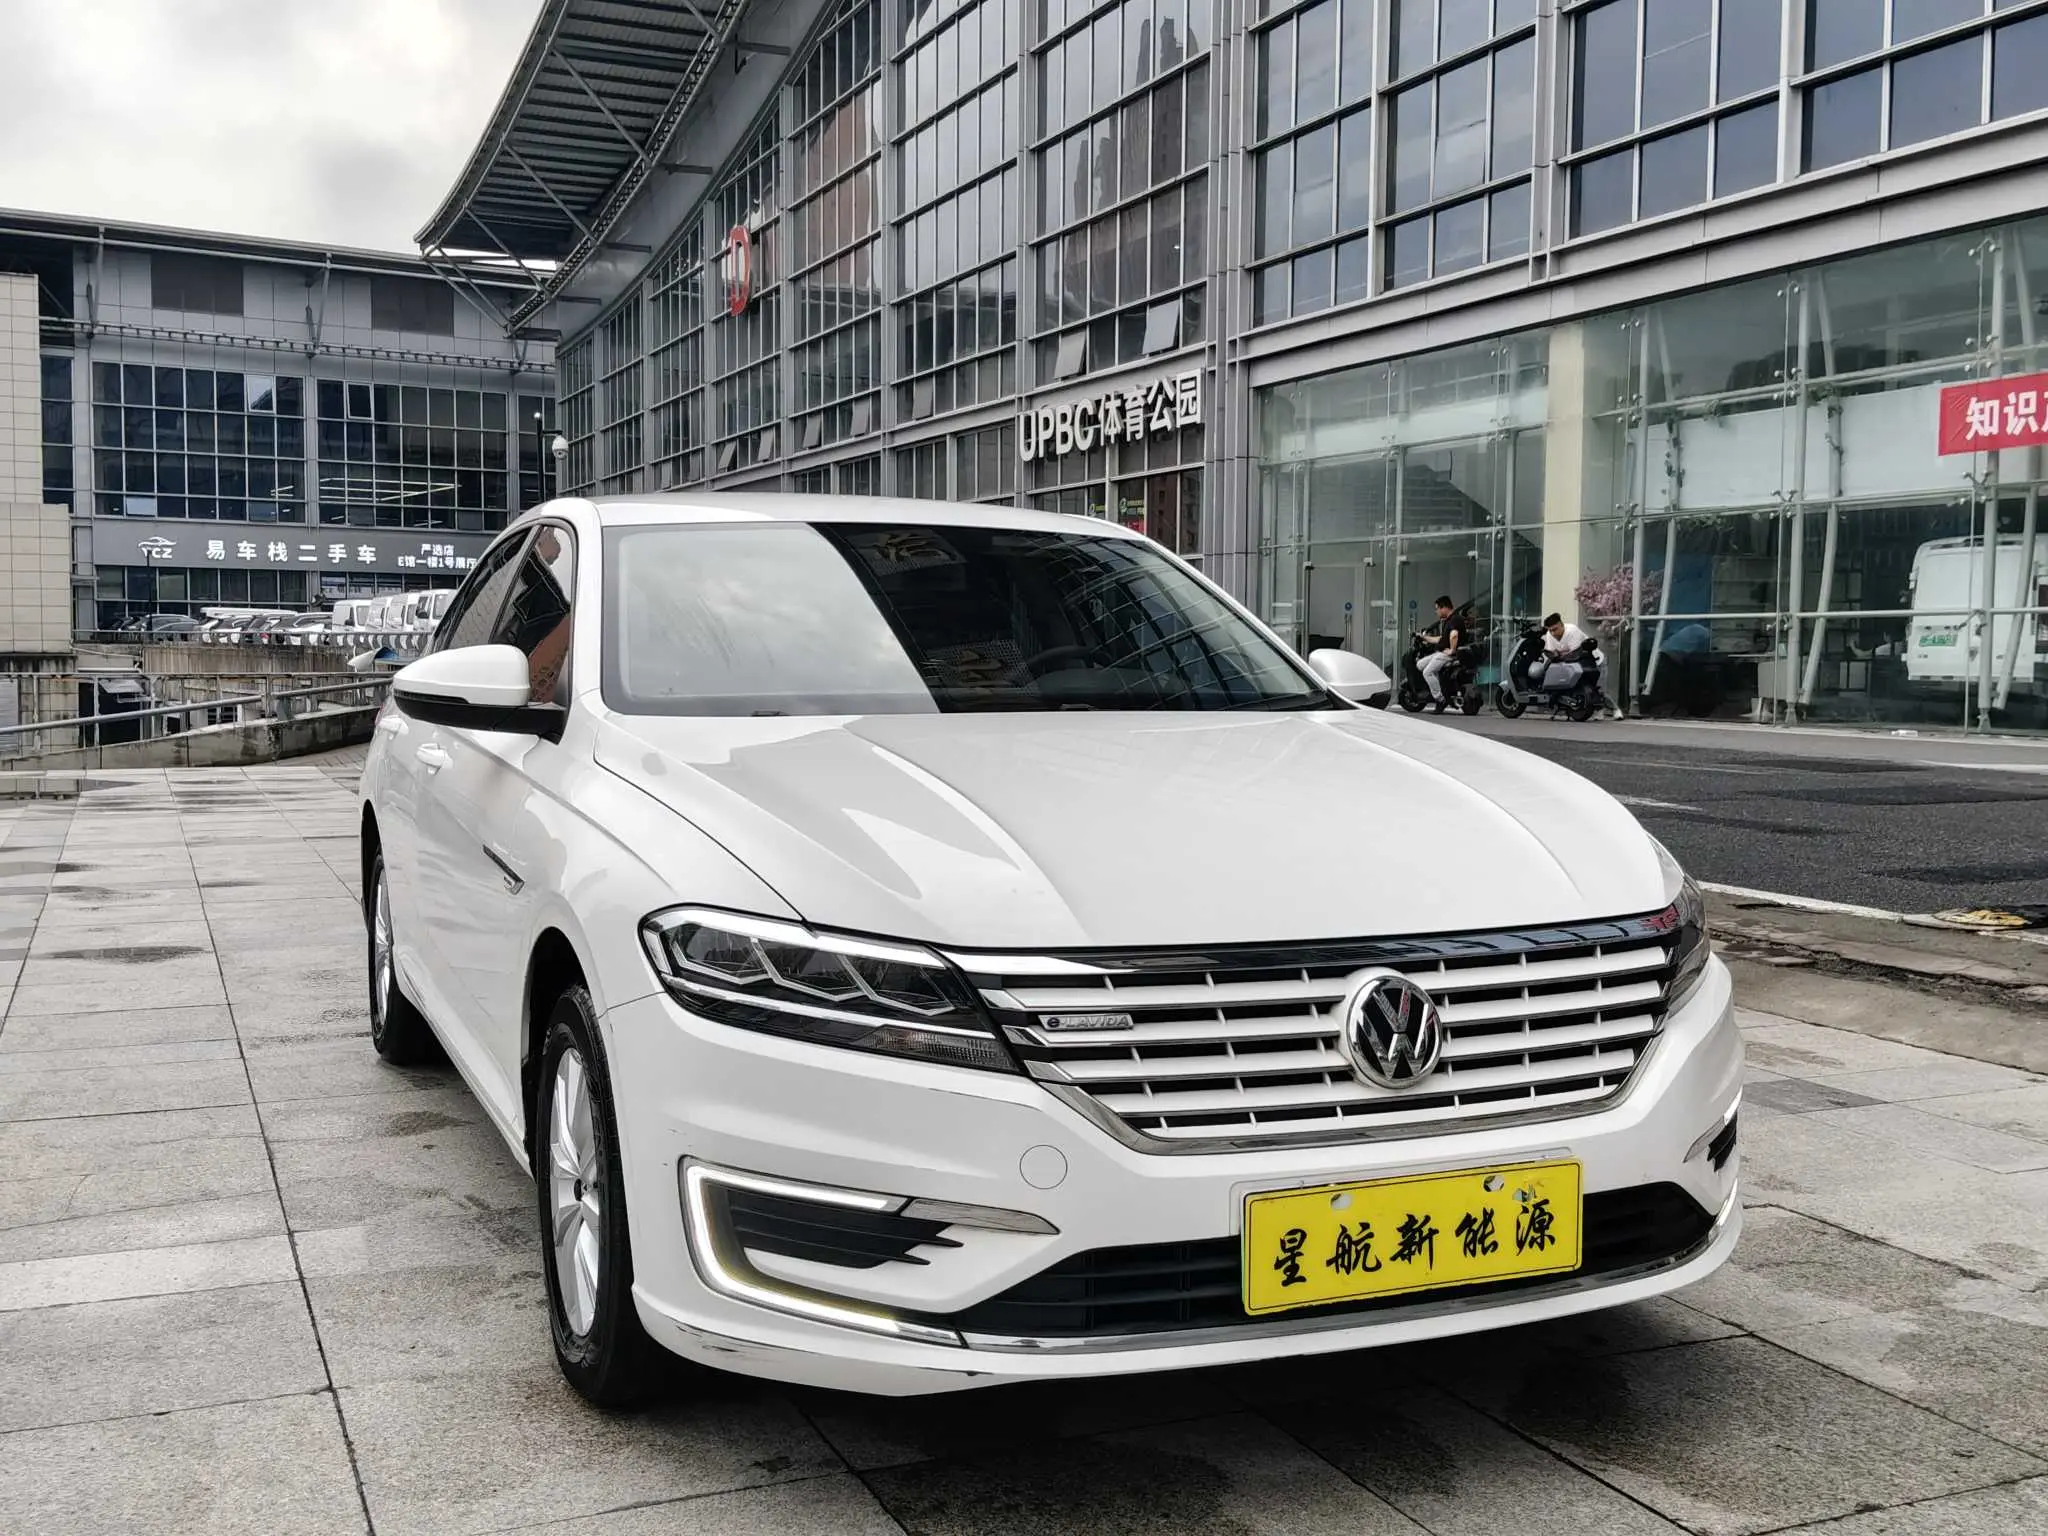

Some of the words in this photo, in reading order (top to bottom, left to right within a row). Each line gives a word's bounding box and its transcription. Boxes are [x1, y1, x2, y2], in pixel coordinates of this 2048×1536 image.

[206, 540, 377, 565] 易车栈二手车
[1273, 1199, 1556, 1287] 星航新能源
